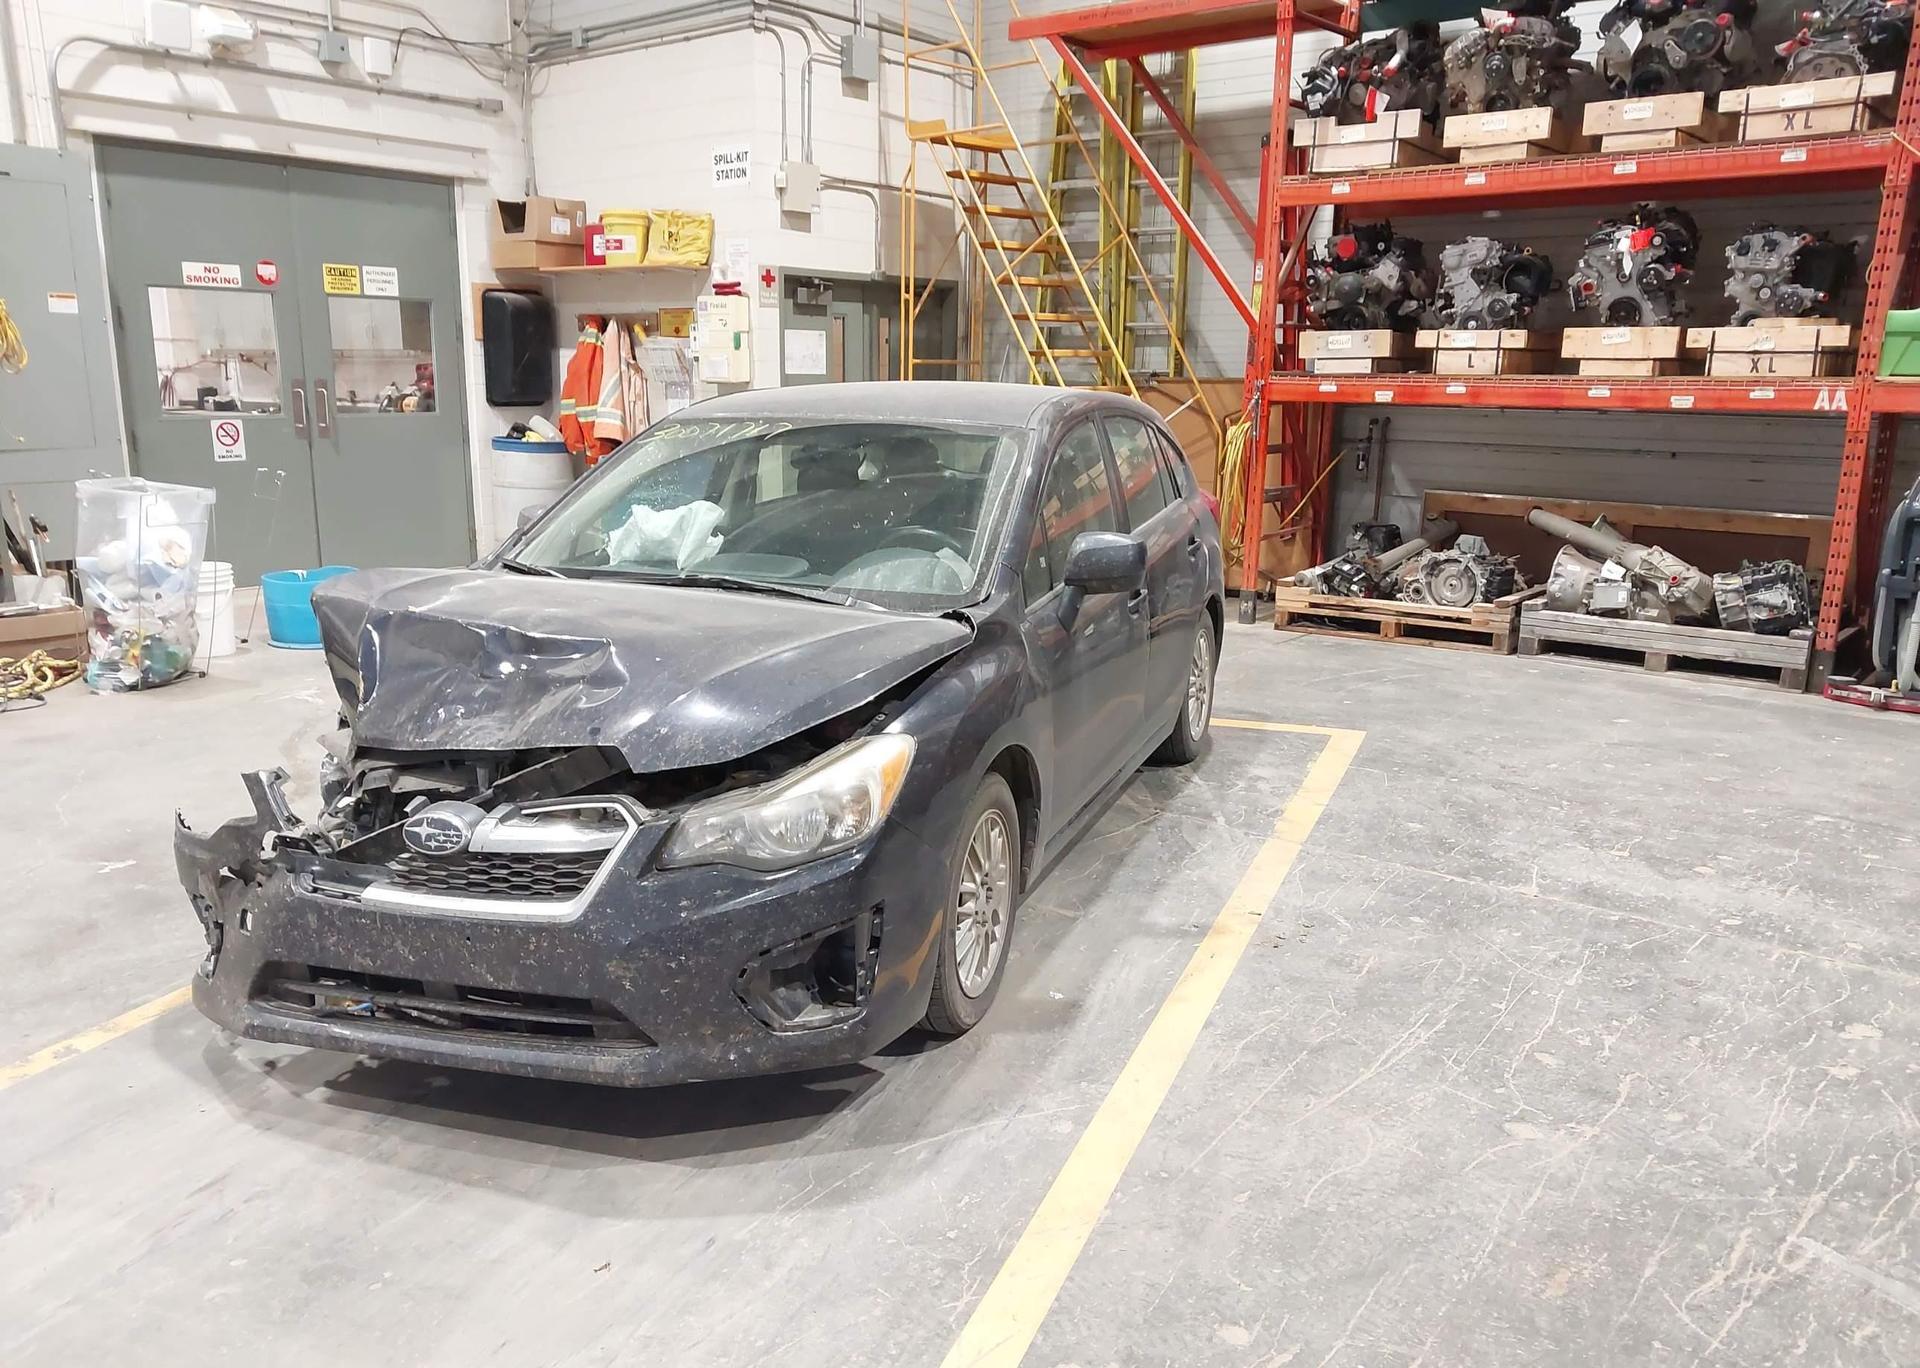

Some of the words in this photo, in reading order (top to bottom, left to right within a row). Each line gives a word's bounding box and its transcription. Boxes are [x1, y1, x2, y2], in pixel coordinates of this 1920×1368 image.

[713, 150, 749, 166] SPILL-KIT
[716, 166, 747, 181] STATION
[203, 265, 220, 274] NO
[326, 267, 357, 277] CAUTION
[186, 274, 240, 285] SMOKING
[1467, 353, 1475, 369] L
[1812, 387, 1848, 410] AA
